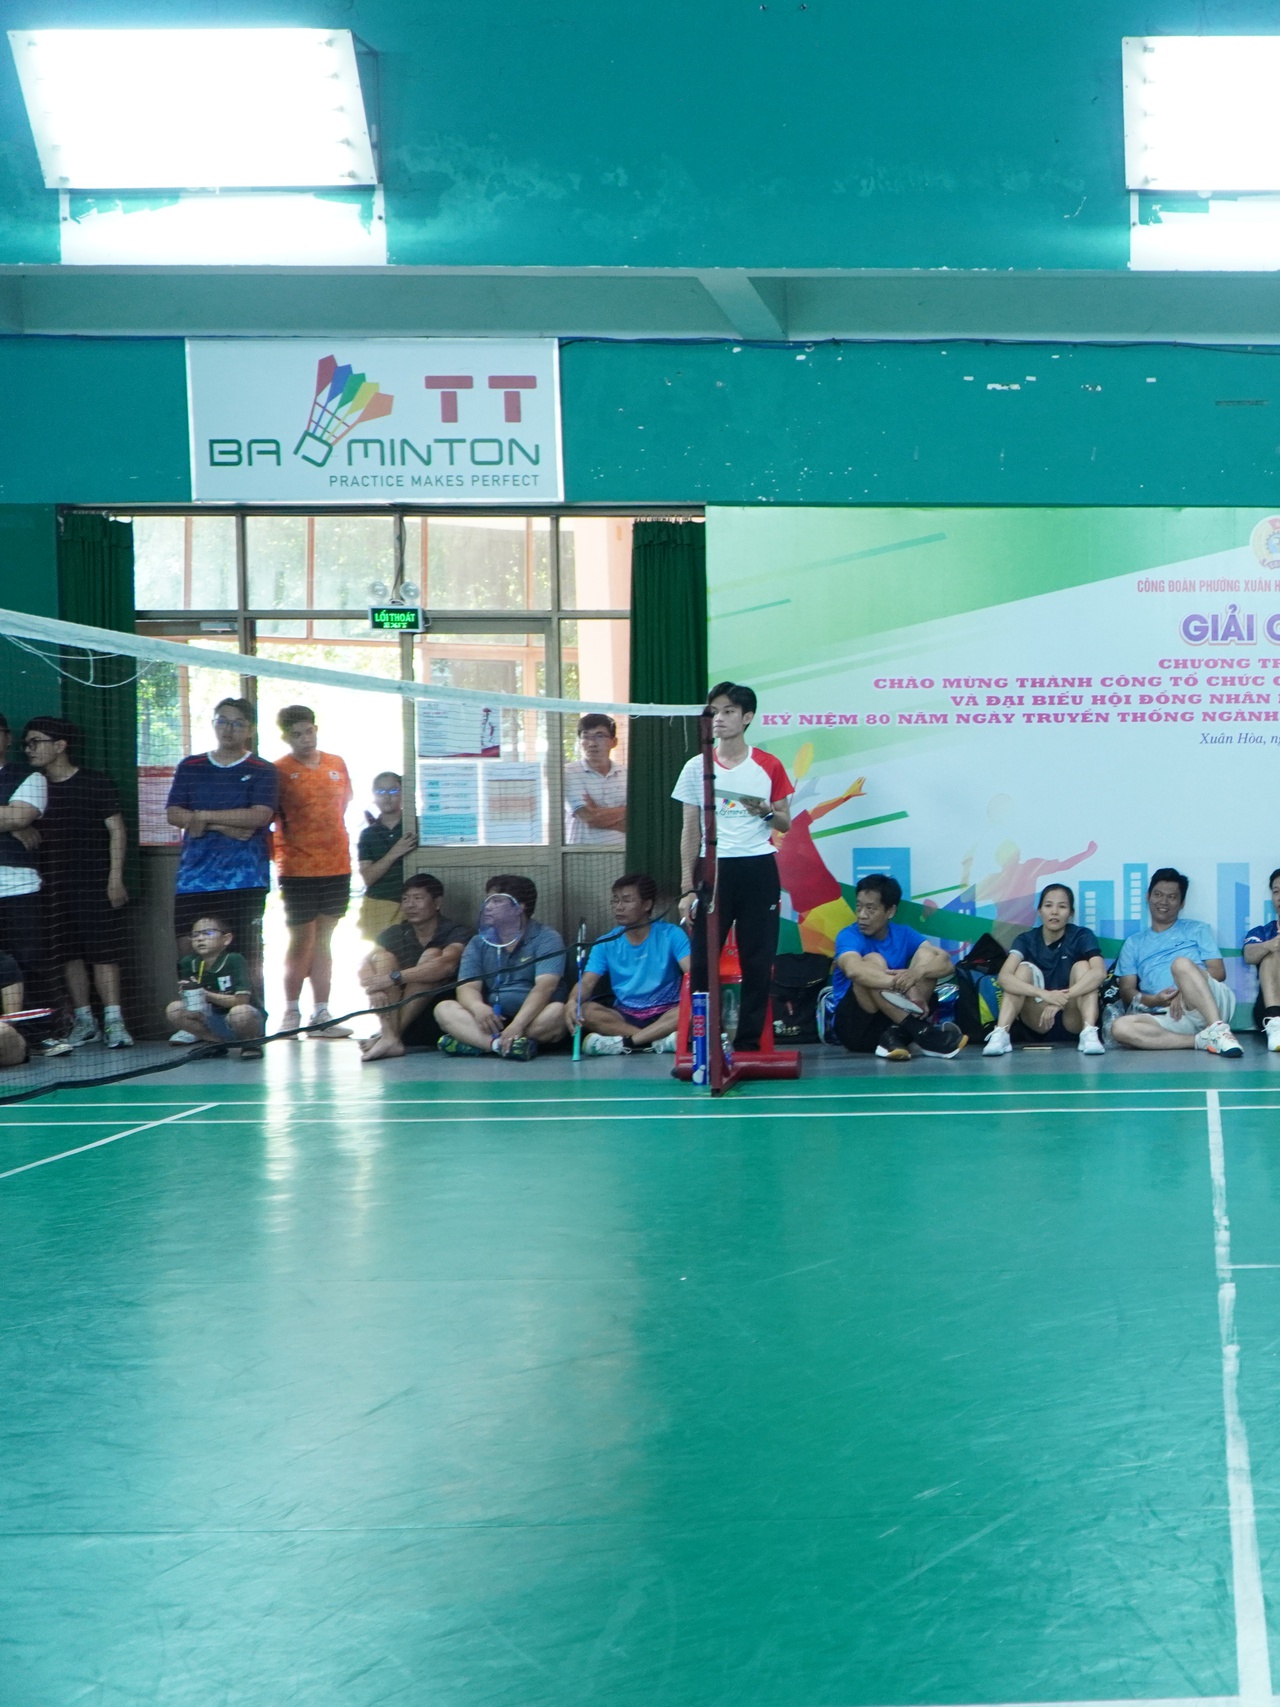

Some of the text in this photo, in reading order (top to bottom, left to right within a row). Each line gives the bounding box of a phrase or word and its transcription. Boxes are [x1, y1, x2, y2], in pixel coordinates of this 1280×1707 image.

[424, 375, 537, 423] TT
[330, 474, 539, 487] PRACTICE MAKES PERFECT
[1137, 578, 1164, 593] CÔNG
[1168, 578, 1196, 593] ĐOÀN
[1199, 578, 1240, 592] PHƯỜNG
[1244, 578, 1271, 592] XUÂN
[1181, 604, 1255, 642] GIẢI
[1158, 657, 1251, 669] CHƯƠNG
[873, 676, 935, 689] CHÀO
[942, 675, 1008, 688] MỪNG
[1016, 675, 1093, 688] THÀNH
[1100, 674, 1162, 688] CÔNG
[1170, 672, 1199, 687] TỔ
[1206, 674, 1265, 687] CHỨC
[951, 693, 979, 706] VÀ
[986, 695, 1025, 708] ĐẠI
[1091, 693, 1132, 707] HỘI
[1139, 690, 1202, 705] ĐỒNG
[1209, 691, 1271, 704] NHÂN
[799, 711, 858, 727] NIỆM
[866, 714, 890, 725] 80
[898, 711, 949, 725] NĂM
[955, 711, 1015, 724] NGÀY
[1023, 708, 1110, 723] TRUYỀN
[1117, 707, 1194, 722] THỐNG
[1201, 709, 1279, 722] NGÀNH
[1200, 732, 1233, 744] Xuân
[1237, 732, 1266, 746] Hòa,
